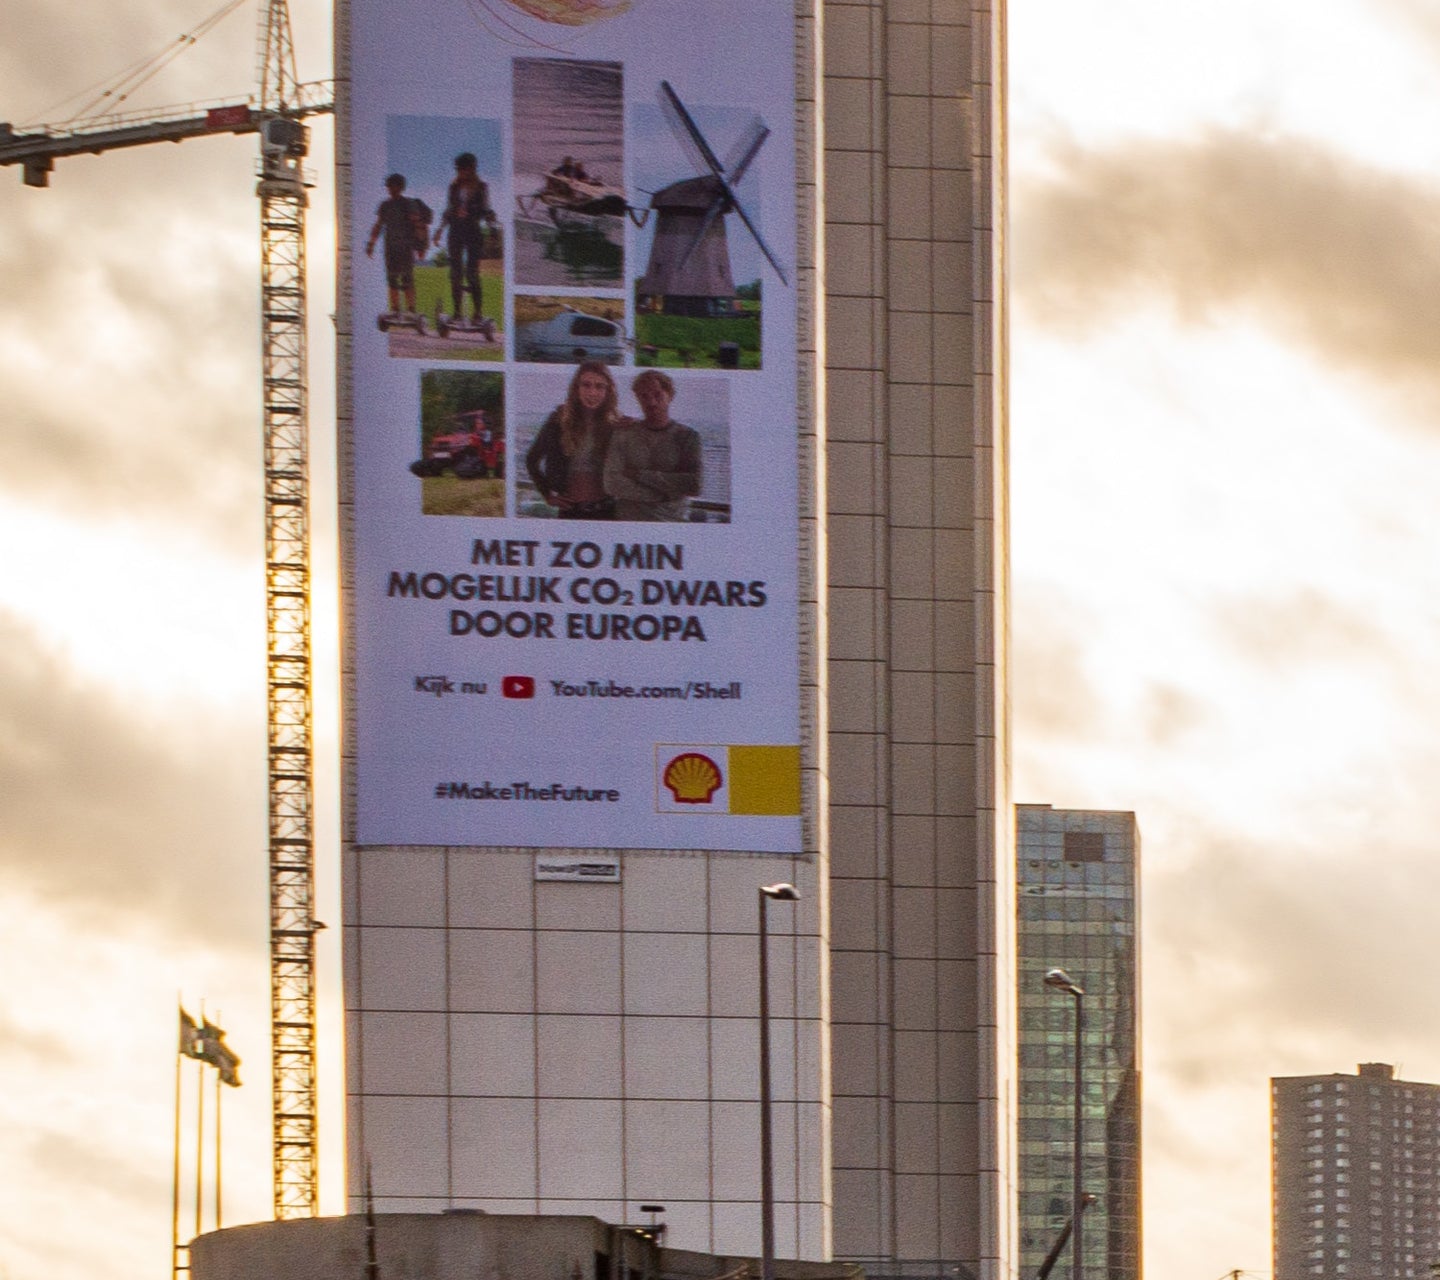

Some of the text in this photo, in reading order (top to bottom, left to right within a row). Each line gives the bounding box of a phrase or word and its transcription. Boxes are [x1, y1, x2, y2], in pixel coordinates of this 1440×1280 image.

[472, 539, 684, 570] MET ZO MIN
[387, 571, 562, 603] MOGELIJK
[641, 579, 767, 608] DWARS
[450, 609, 707, 642] DOOR EUROPA
[414, 675, 742, 700] Kijk nu YouTube.com/Shell
[434, 781, 620, 802] #MakeTheFuture
